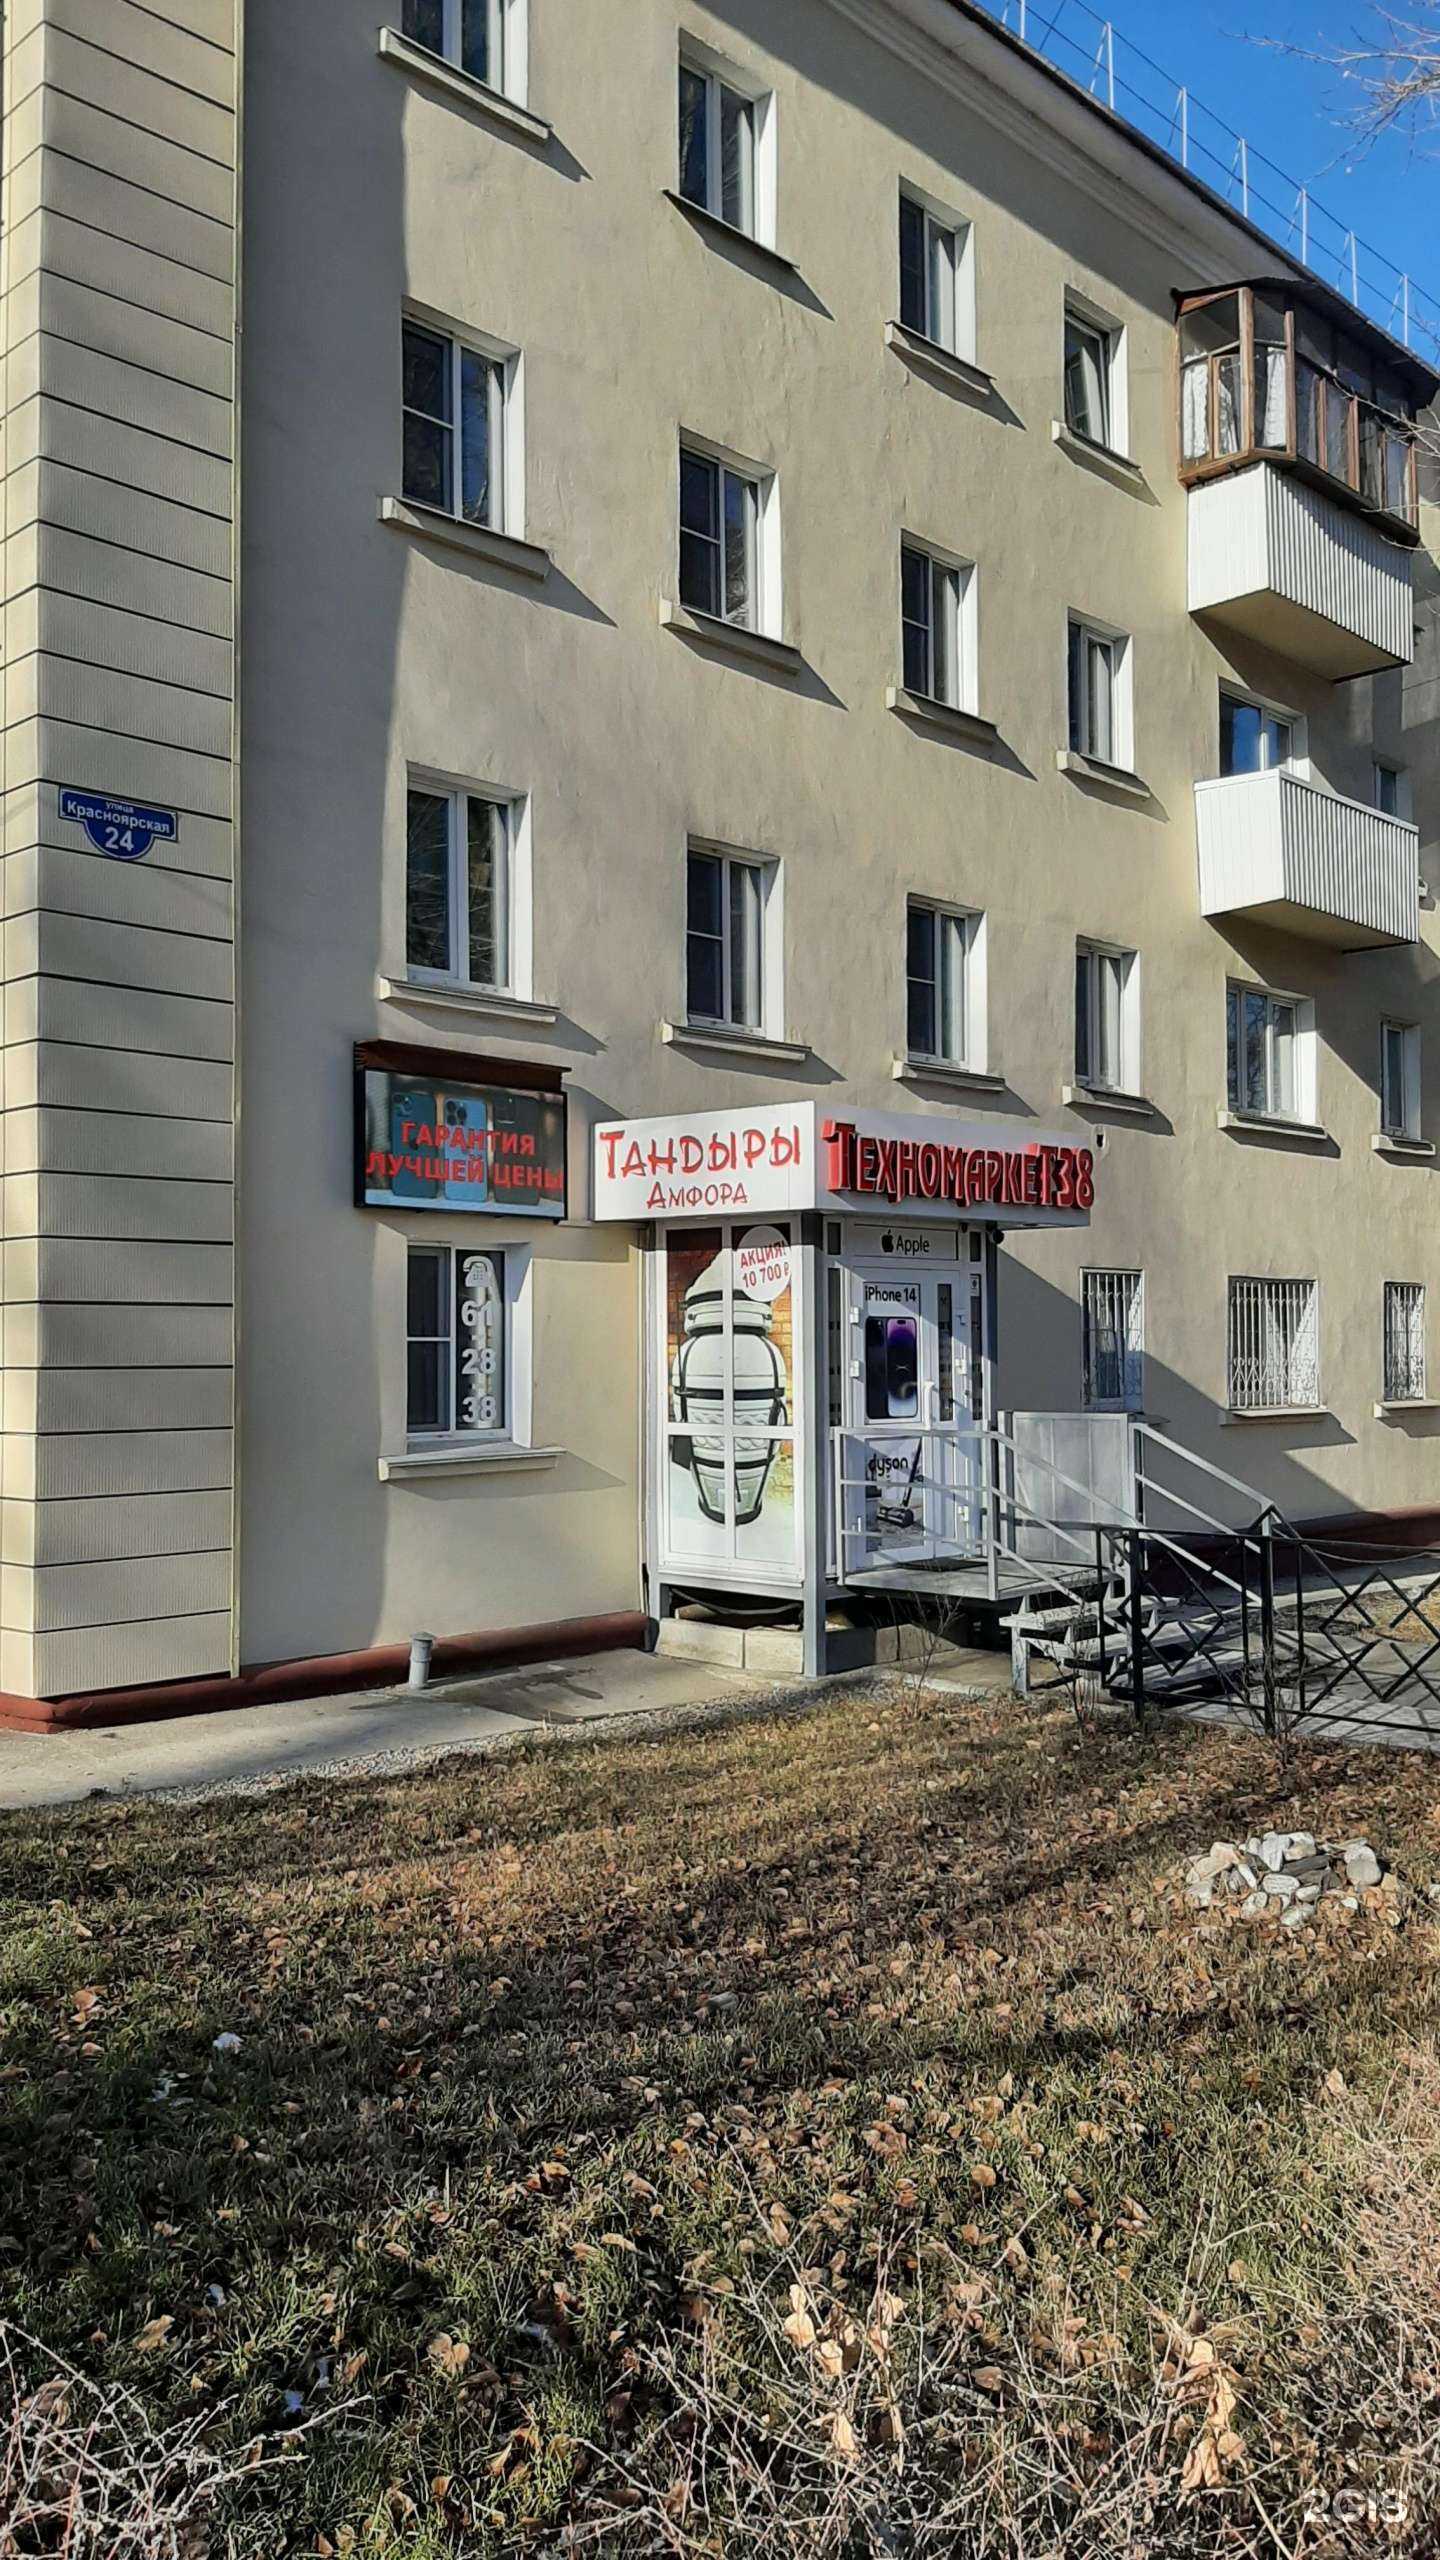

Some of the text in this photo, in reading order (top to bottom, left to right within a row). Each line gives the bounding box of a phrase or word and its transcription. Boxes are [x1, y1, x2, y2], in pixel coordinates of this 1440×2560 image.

[67, 800, 170, 833] Красноярская
[105, 801, 134, 814] улица
[105, 826, 134, 851] 24
[401, 1120, 535, 1156] ГАРАНТИЯ
[599, 1125, 801, 1179] ТАНДЫРЫ
[365, 1151, 564, 1190] ЛУЧШЕЙ ЦЕНЫ
[646, 1181, 748, 1210] АМФОРА
[740, 1240, 787, 1268] АКЦИЯ!
[896, 1235, 931, 1256] Apple
[743, 1270, 757, 1288] 10
[759, 1263, 782, 1284] 700
[864, 1285, 917, 1302] iPhone 14
[461, 1347, 497, 1375] 28
[461, 1395, 497, 1423] 38
[868, 1453, 909, 1477] dyson
